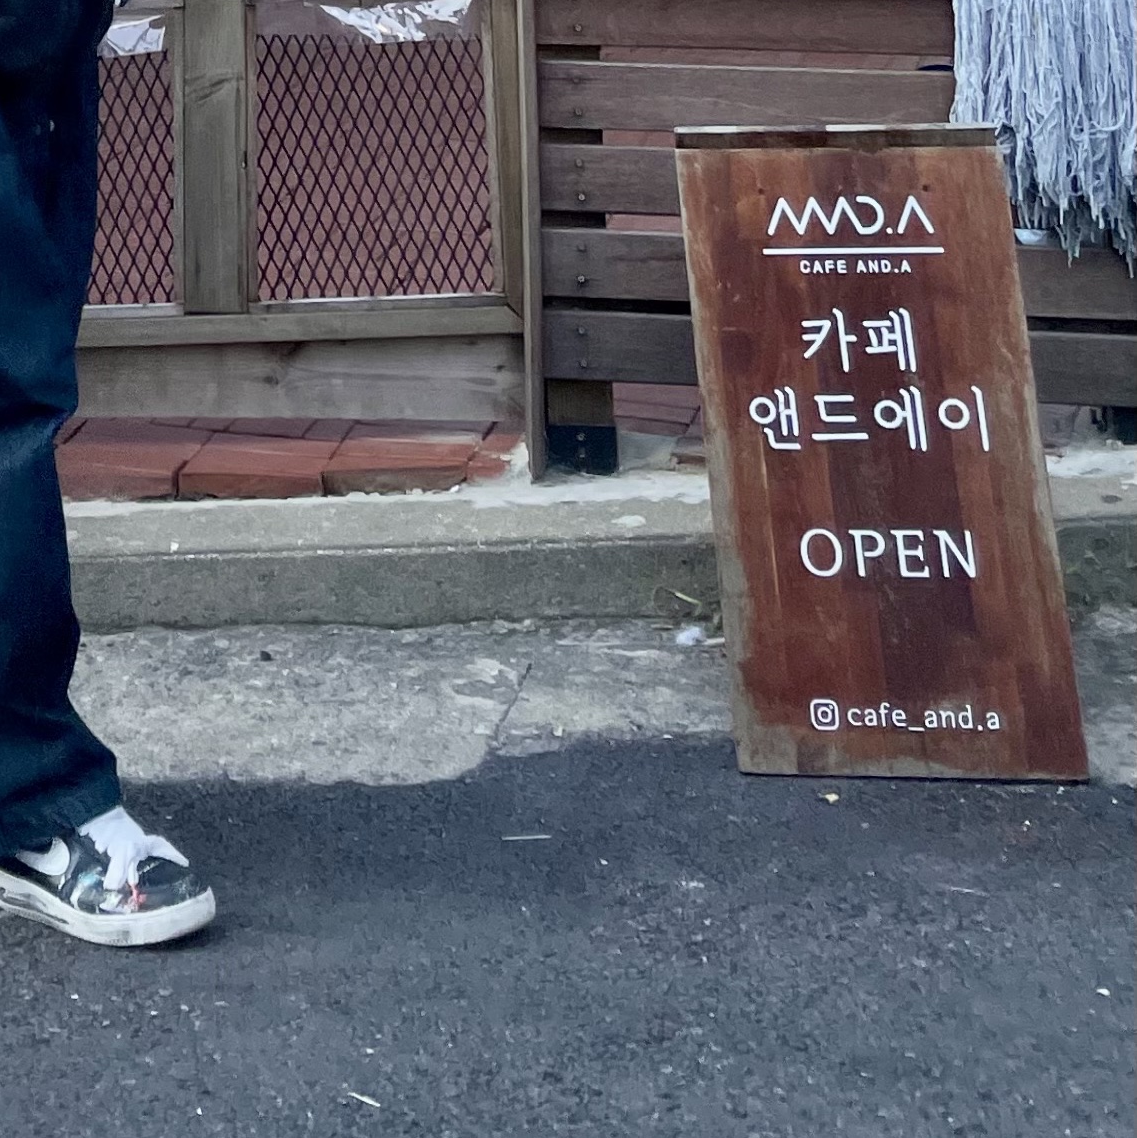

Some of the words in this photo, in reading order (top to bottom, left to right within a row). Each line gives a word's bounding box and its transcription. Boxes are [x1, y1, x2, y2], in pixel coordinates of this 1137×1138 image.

[799, 259, 848, 274] CAFE
[856, 259, 911, 274] AND.A
[800, 307, 917, 373] 카페
[748, 385, 990, 452] 앤드에이
[799, 527, 978, 578] OPEN
[846, 702, 1001, 732] cafe_and.a
